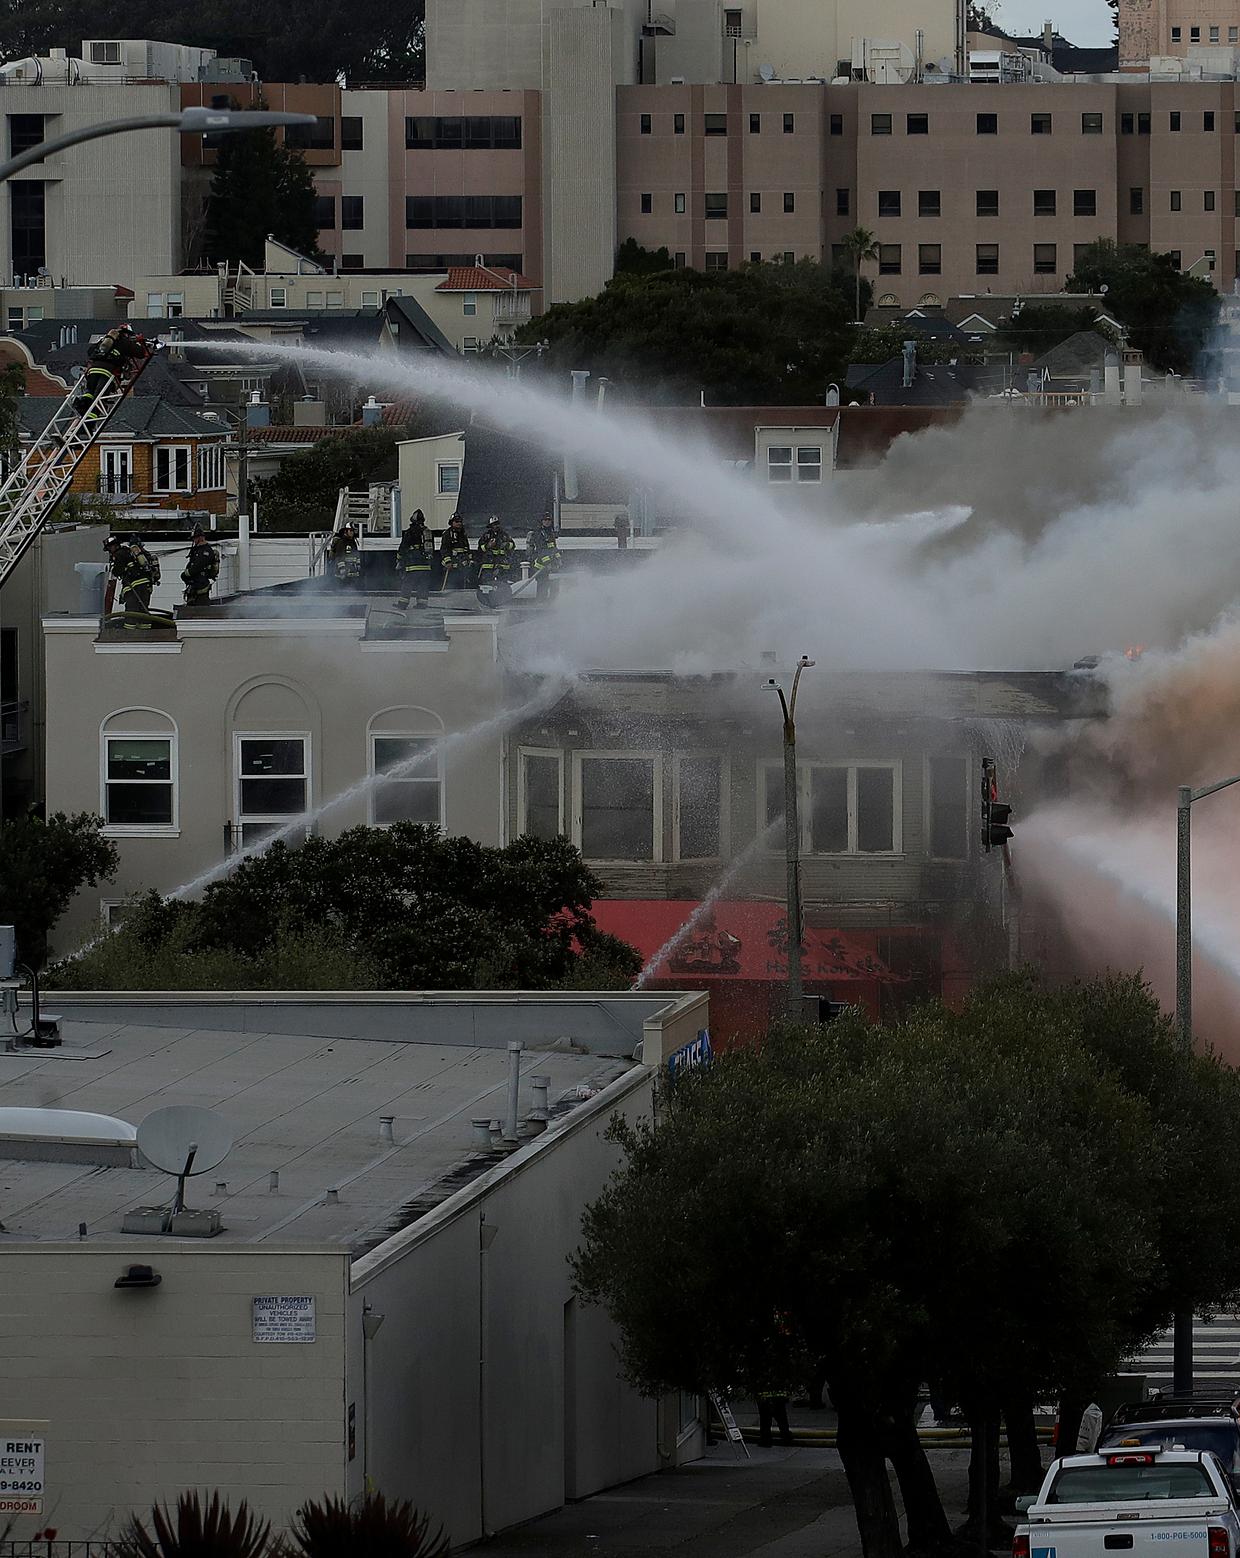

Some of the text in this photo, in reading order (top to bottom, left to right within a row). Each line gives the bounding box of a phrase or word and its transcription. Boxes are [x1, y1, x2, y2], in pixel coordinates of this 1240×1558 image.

[7, 1443, 41, 1453] RENT
[1, 1458, 35, 1467] EEVER
[0, 1481, 42, 1491] 9-8420
[1150, 1532, 1207, 1540] 1-800-PGE-5000
